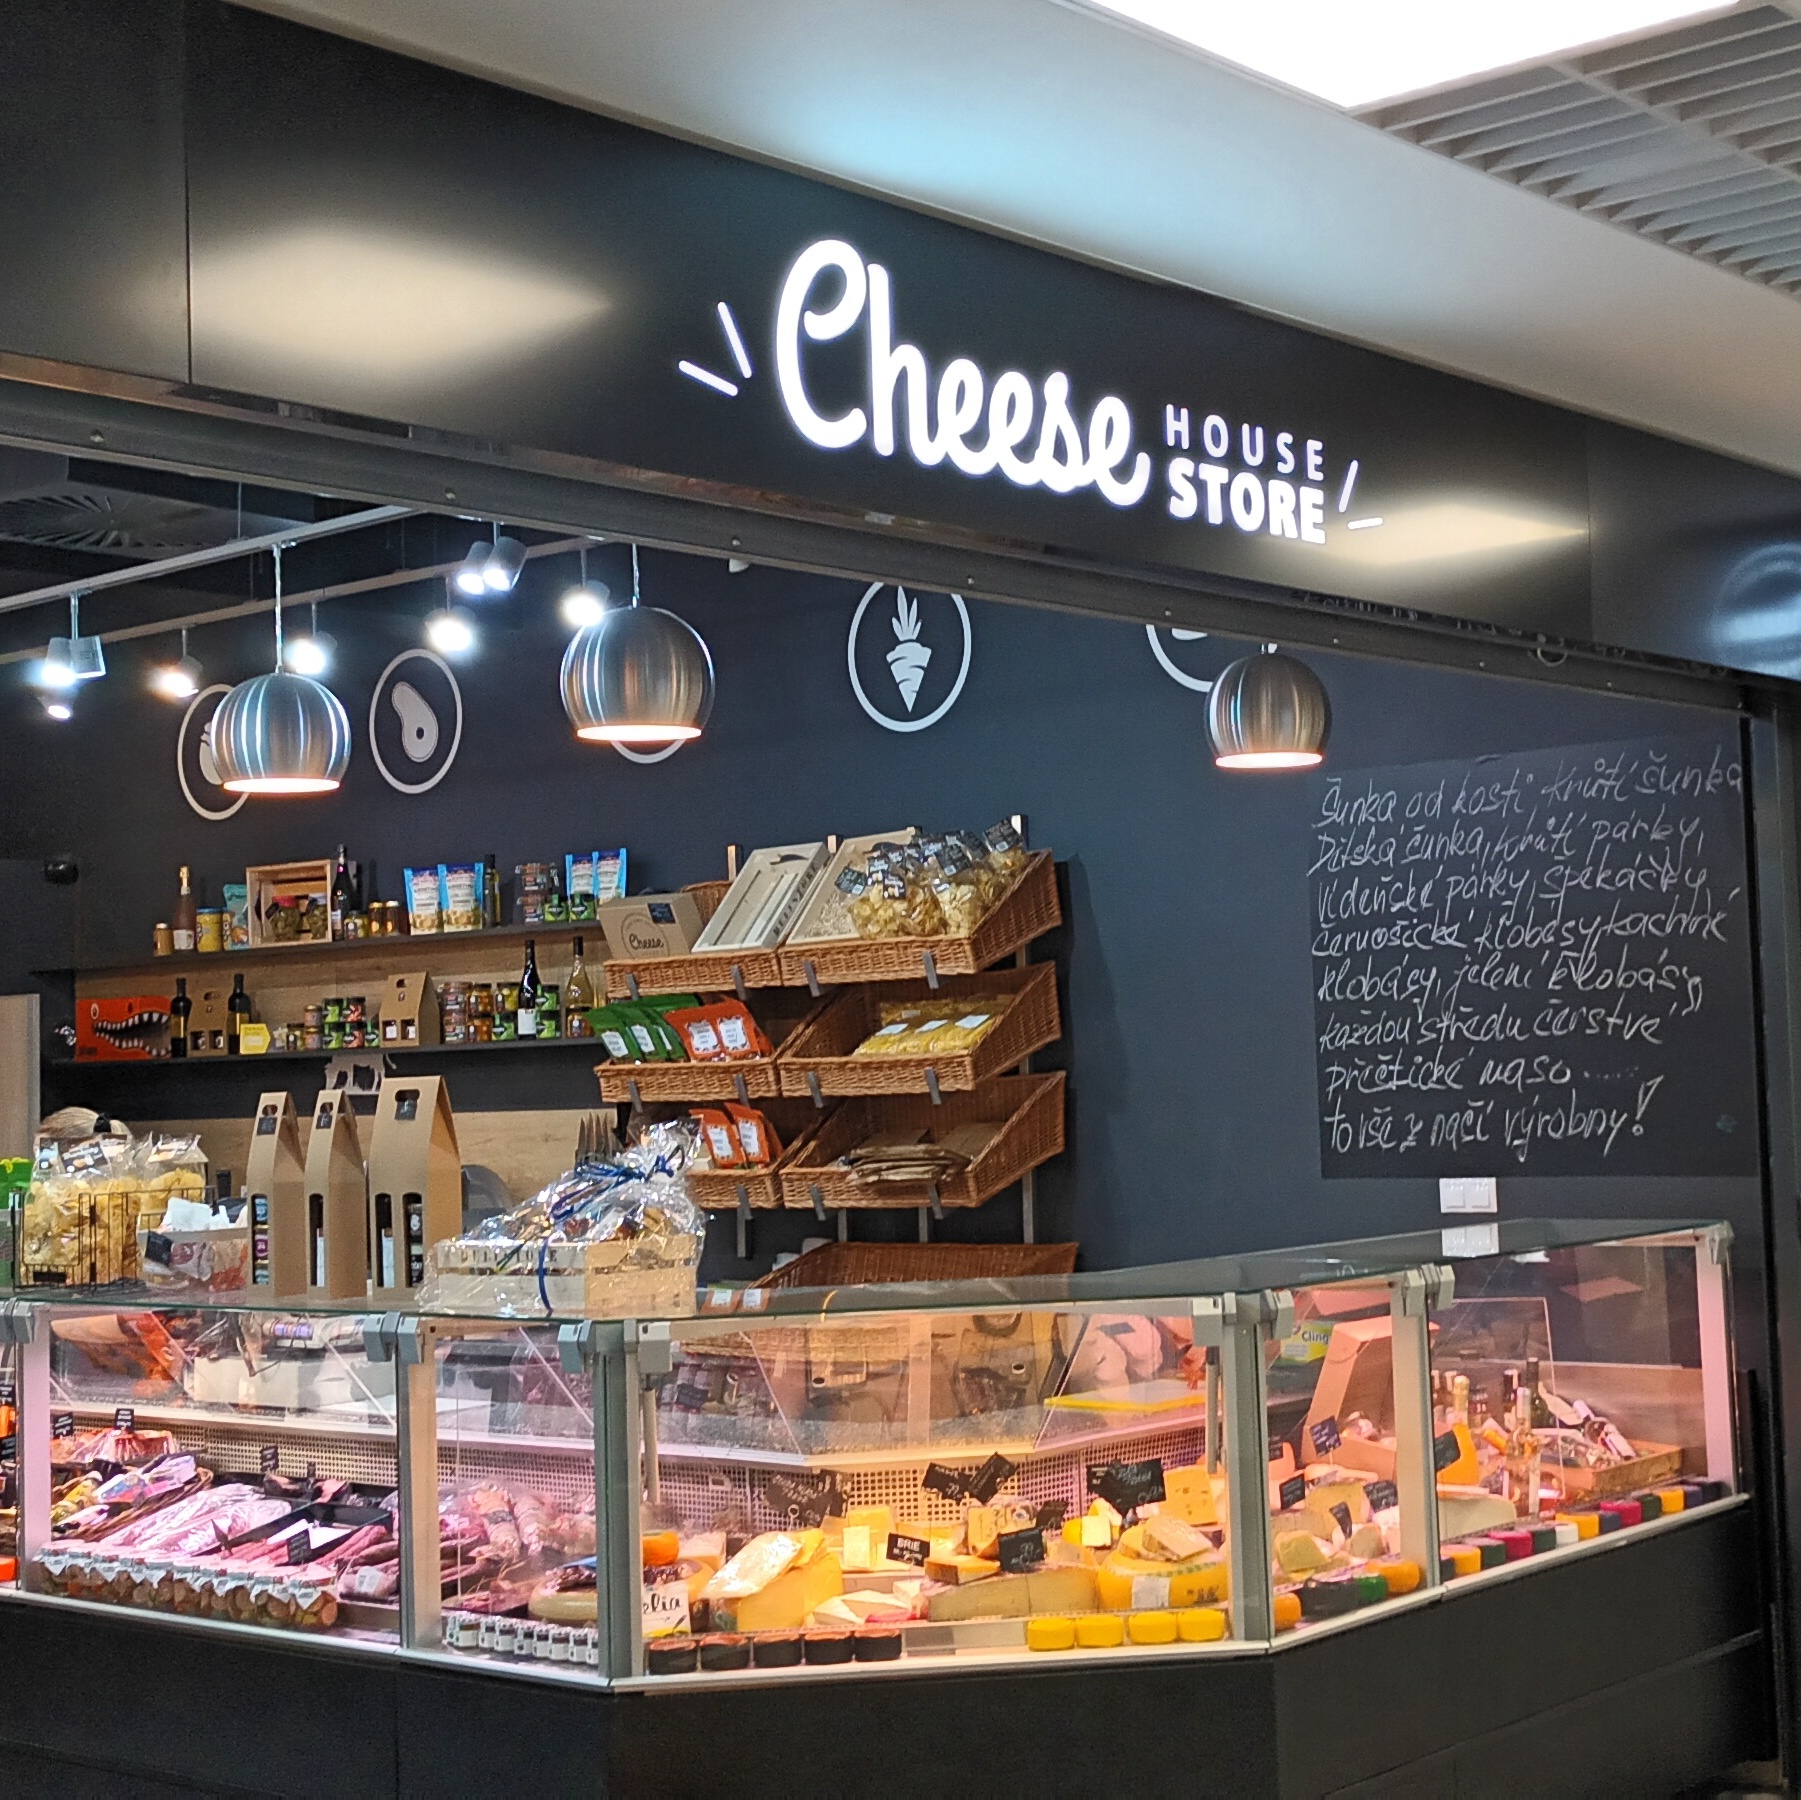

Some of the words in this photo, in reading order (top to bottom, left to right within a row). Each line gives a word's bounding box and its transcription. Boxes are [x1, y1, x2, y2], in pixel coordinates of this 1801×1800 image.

[776, 239, 1151, 506] Cheese
[1166, 404, 1324, 481] HOUSE
[1168, 457, 1326, 544] STORE
[1311, 777, 1397, 828] Šunka
[1405, 778, 1446, 819] od
[629, 933, 665, 951] Cheese
[1324, 1095, 1352, 1153] to
[1359, 1106, 1396, 1149] vše
[1301, 1330, 1329, 1345] Cling
